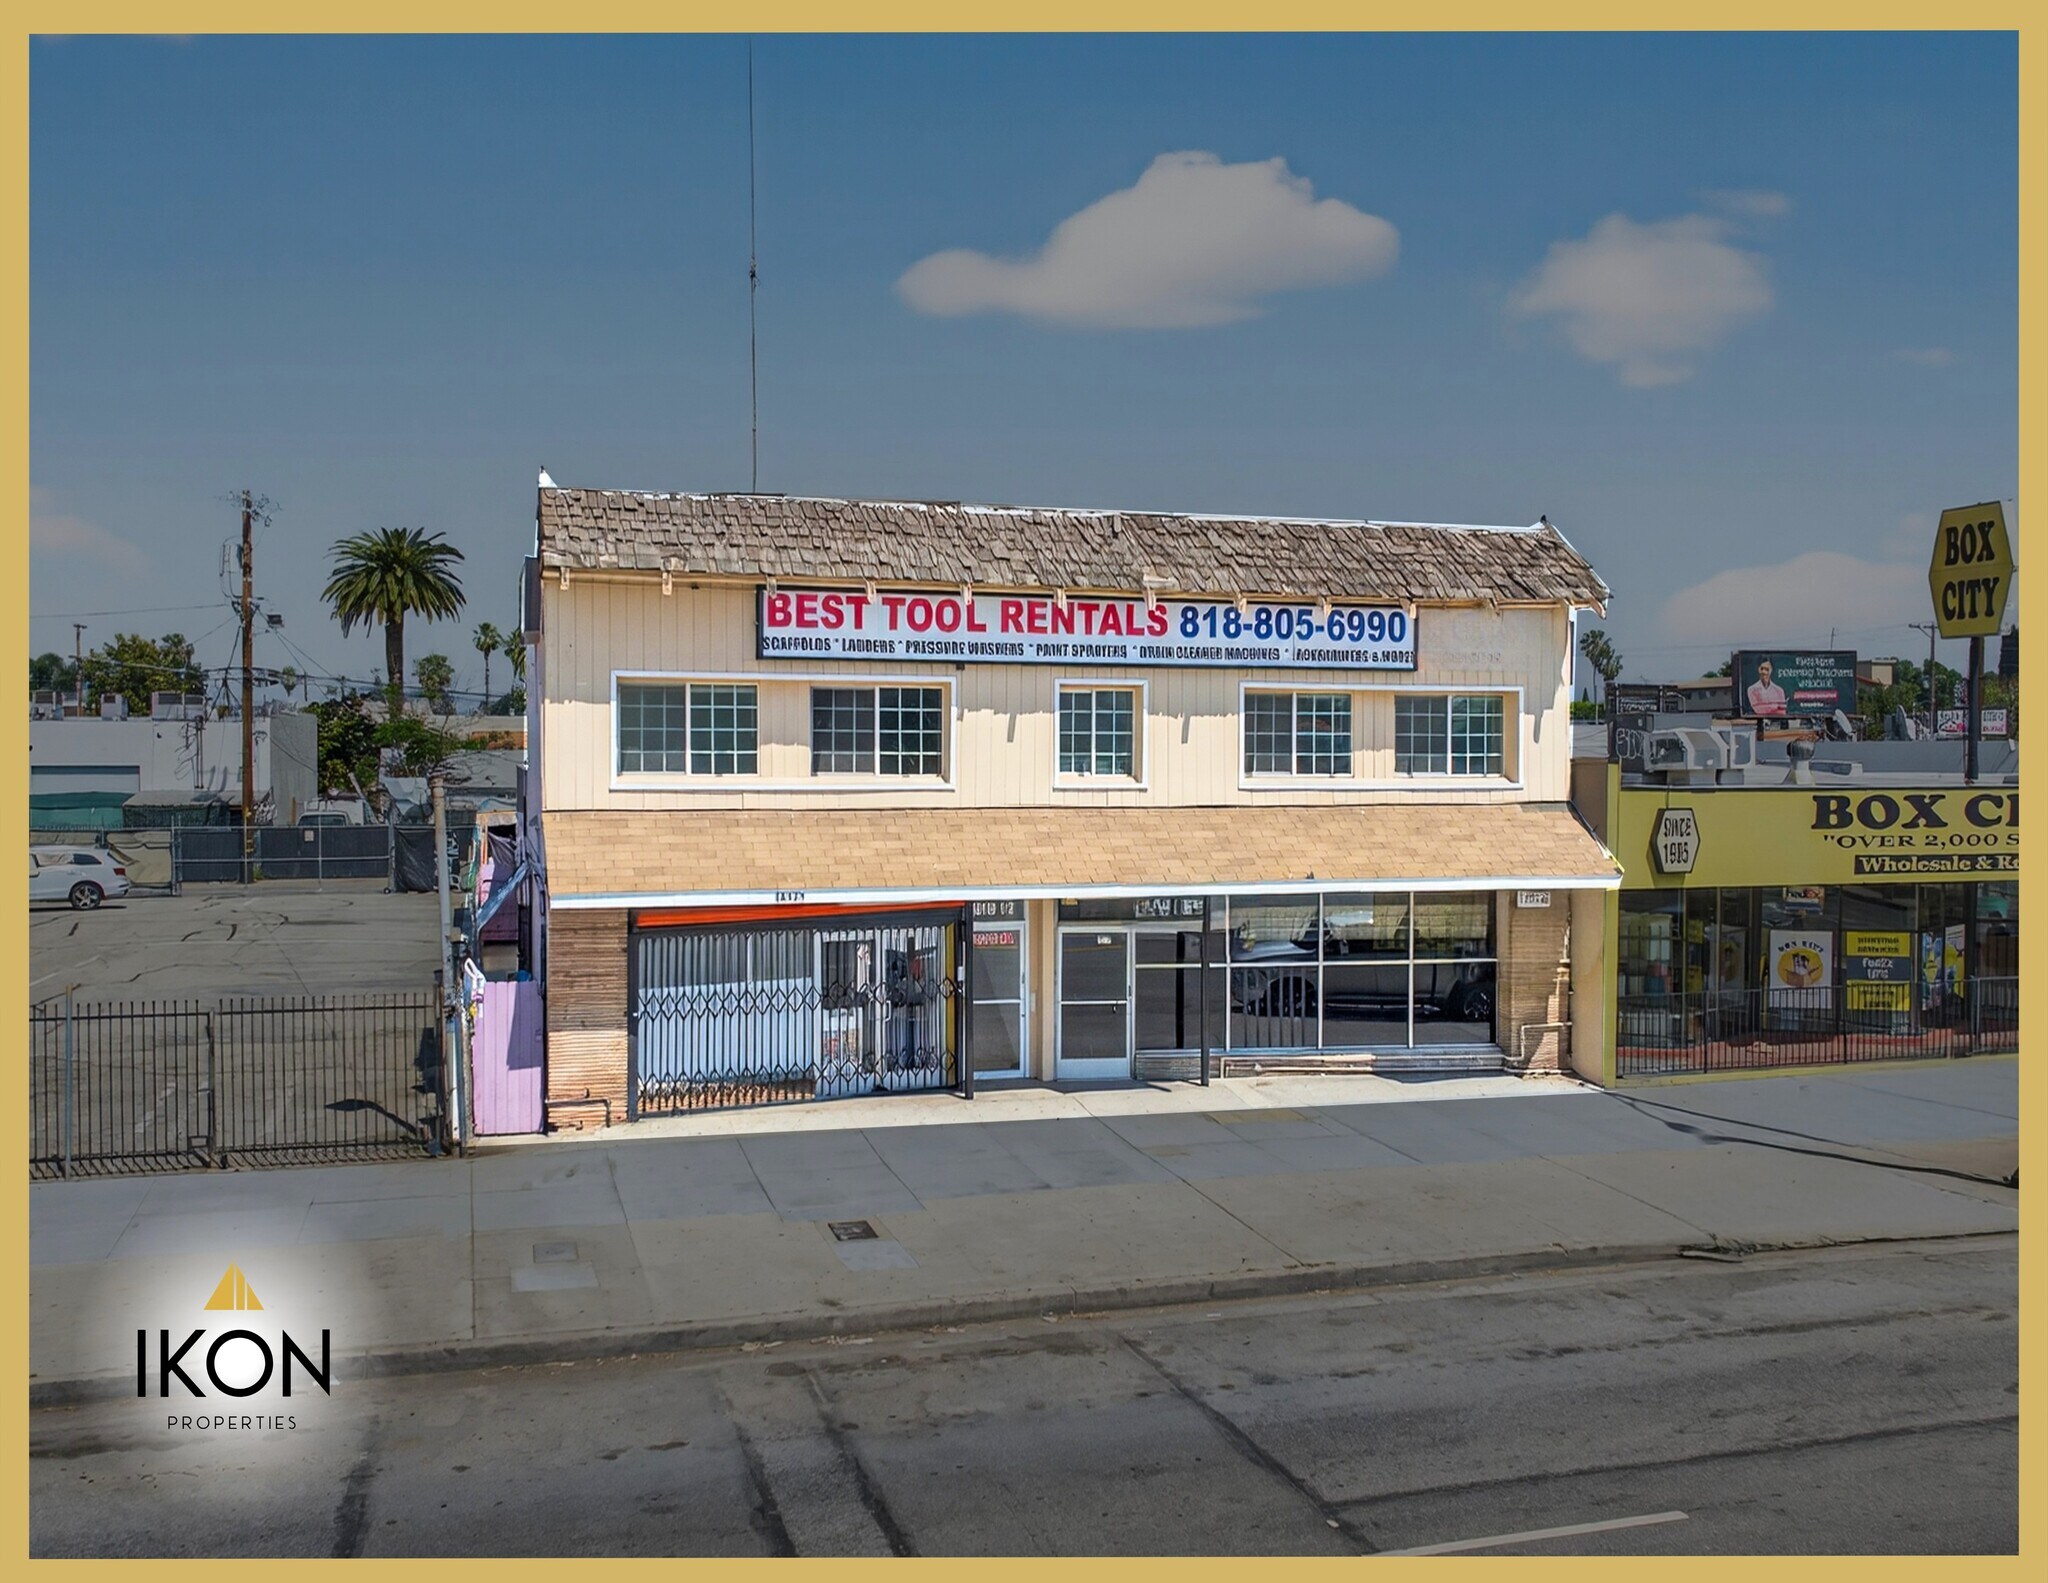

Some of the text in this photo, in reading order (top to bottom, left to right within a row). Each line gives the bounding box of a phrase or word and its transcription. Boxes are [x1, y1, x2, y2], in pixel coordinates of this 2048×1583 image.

[1945, 520, 1995, 566] BOX
[767, 593, 1407, 643] BEST TOOL RENTALS 818-805-6990
[1942, 577, 2000, 621] CITY
[1811, 794, 1948, 830] BOX
[1924, 833, 1999, 850] 2,000
[1859, 856, 1970, 872] Wholesale
